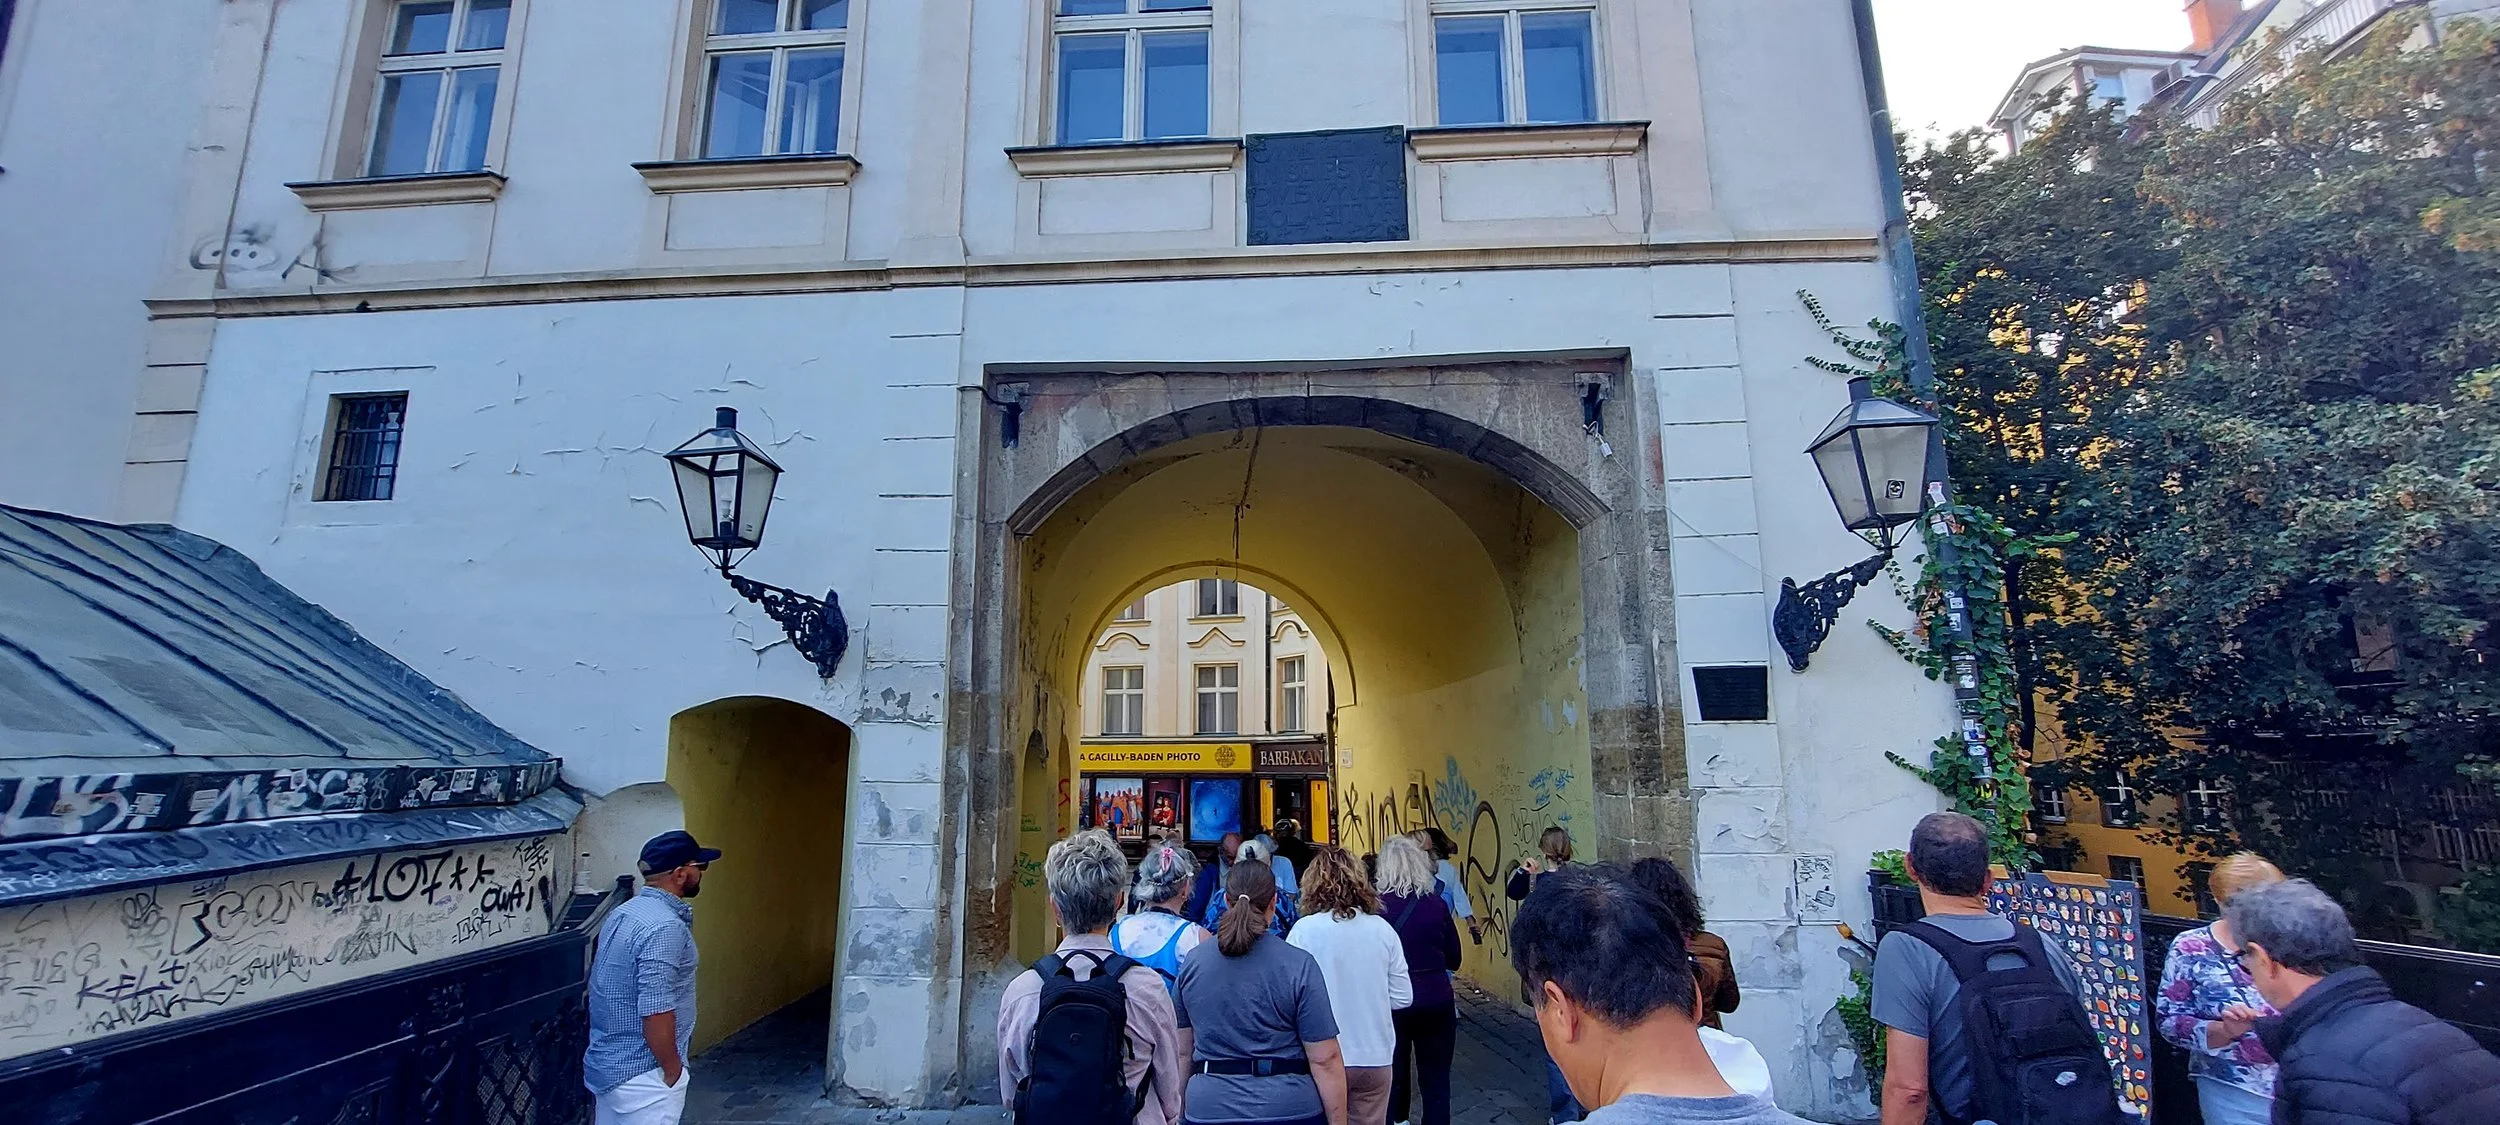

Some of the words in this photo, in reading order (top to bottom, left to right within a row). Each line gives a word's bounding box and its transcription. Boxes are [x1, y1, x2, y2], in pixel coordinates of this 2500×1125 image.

[1088, 752, 1163, 761] GACILLY-BADEN
[1167, 752, 1201, 761] PHOTO
[1260, 749, 1324, 766] BARBAKAN
